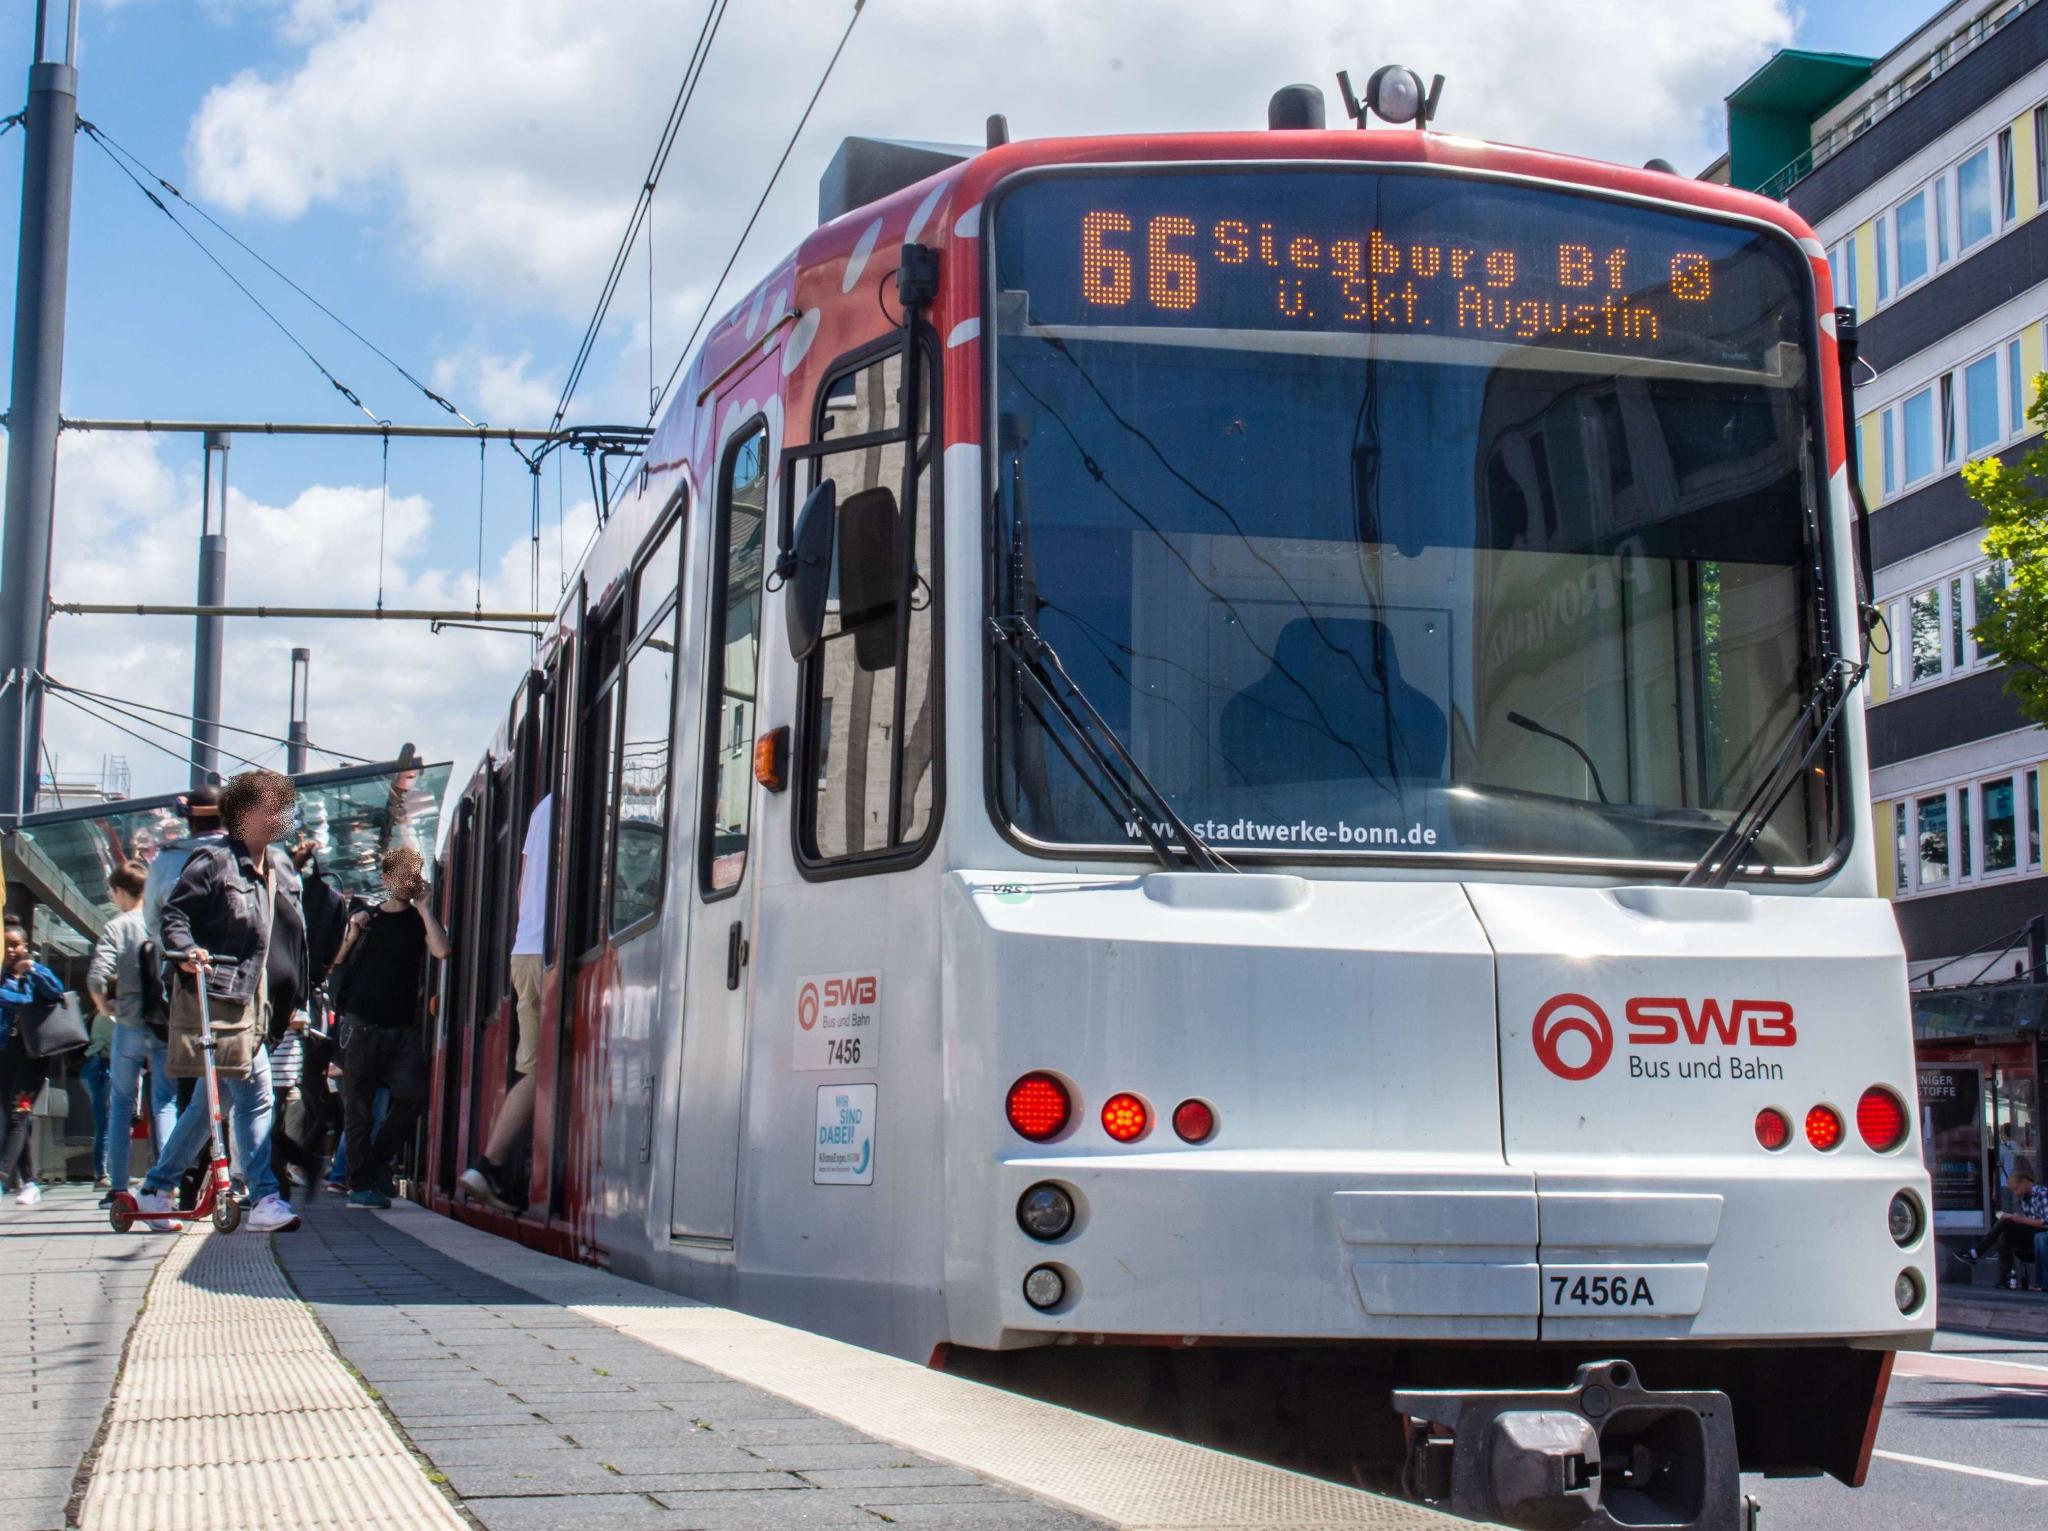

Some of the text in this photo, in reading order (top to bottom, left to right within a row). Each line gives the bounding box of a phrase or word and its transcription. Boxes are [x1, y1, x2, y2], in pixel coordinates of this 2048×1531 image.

[1082, 210, 1627, 310] 66 Siegburg Bf
[1342, 278, 1430, 324] Skt.
[1457, 284, 1659, 339] Augustin
[1124, 817, 1437, 845] wwstadtwerke-bonn.de
[823, 976, 877, 1008] SWB
[823, 1012, 871, 1029] Bus und Bahn
[1625, 997, 1797, 1047] SWB
[827, 1038, 861, 1065] 7456
[1629, 1055, 1784, 1080] Bus und Bahn
[840, 1108, 863, 1125] SIND
[820, 1126, 855, 1145] DABEI!
[1550, 1275, 1655, 1306] 7456A
